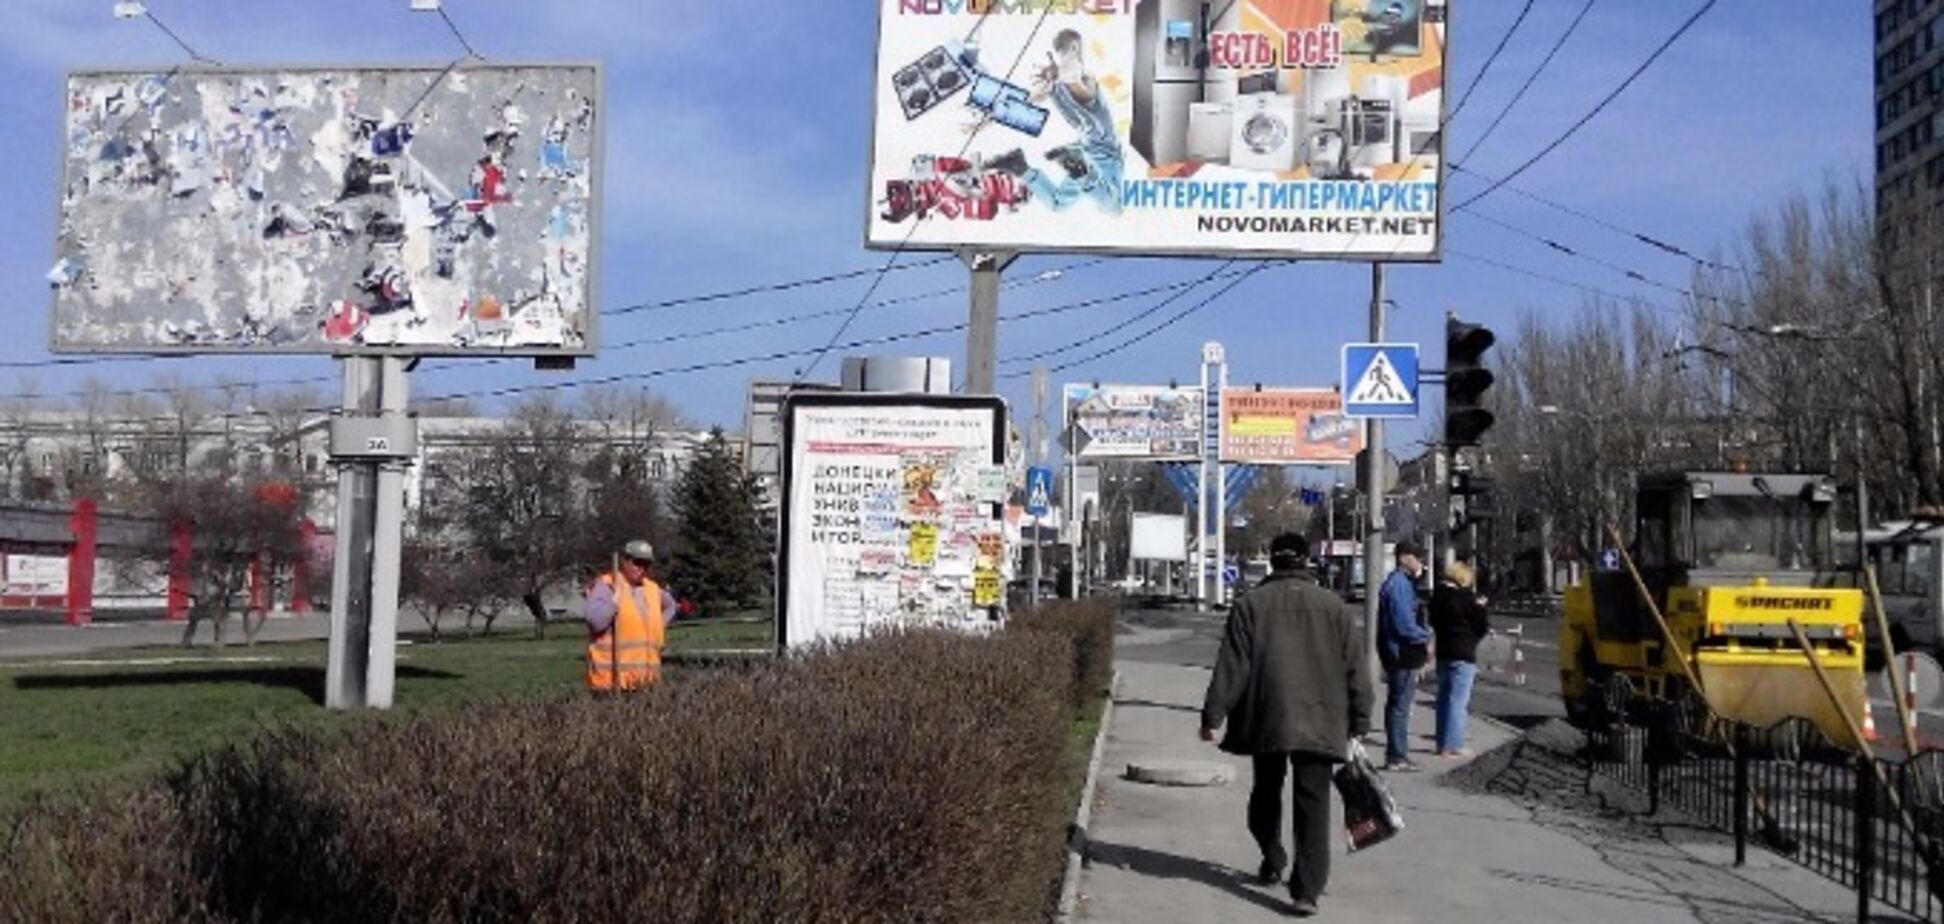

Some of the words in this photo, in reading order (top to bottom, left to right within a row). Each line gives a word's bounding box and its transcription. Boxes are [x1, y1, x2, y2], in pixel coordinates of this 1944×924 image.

[1210, 33, 1272, 66] ЕСТЬ
[1285, 25, 1340, 64] ВСЁ!
[1122, 179, 1436, 212] ИНТЕРНЕТ-ГИПЕРМАРКЕТ
[1197, 215, 1434, 235] NOVOMARKET.NET
